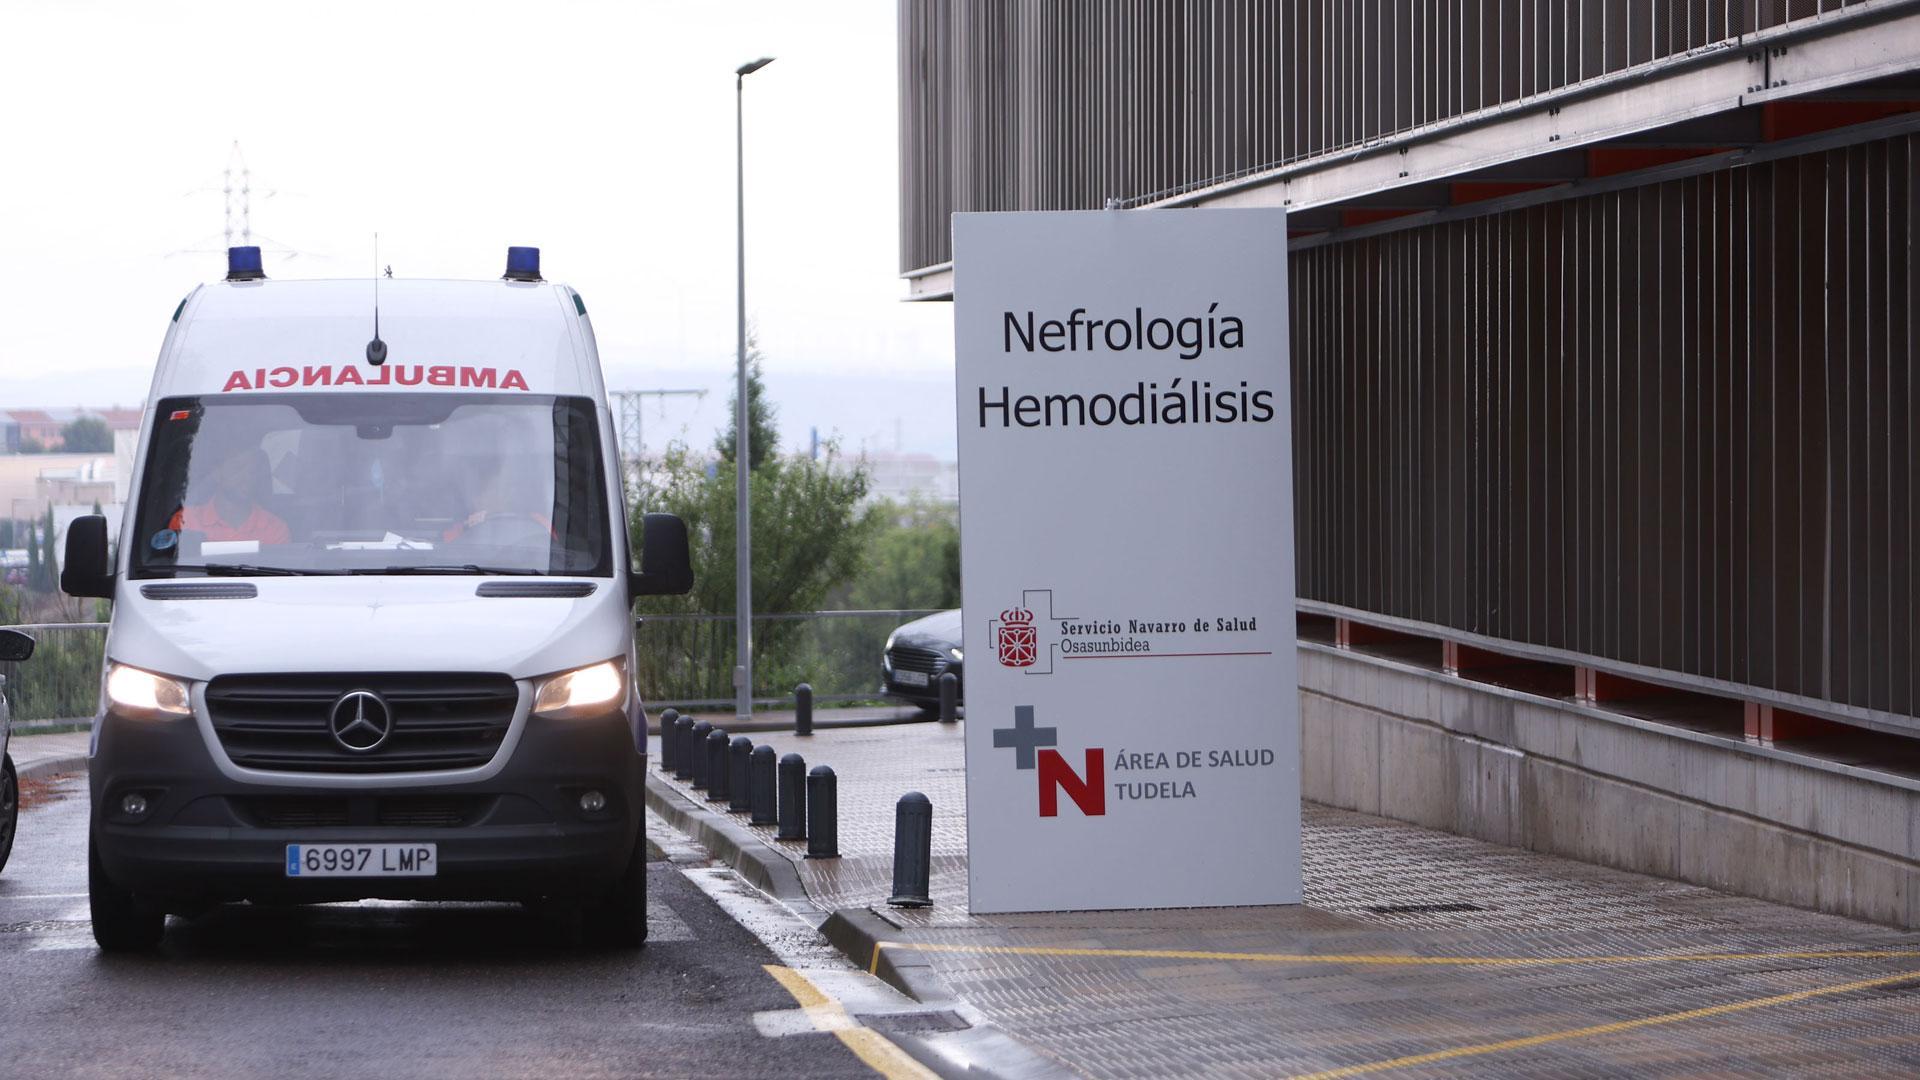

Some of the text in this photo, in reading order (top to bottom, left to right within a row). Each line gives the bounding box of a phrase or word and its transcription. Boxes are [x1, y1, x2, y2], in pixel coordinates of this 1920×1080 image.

[1004, 302, 1244, 360] Nefrología
[978, 378, 1274, 428] Hemodiálisis
[1060, 616, 1257, 636] Servicio Navarro de Salud
[1060, 637, 1151, 654] Osasunbidea
[1114, 748, 1275, 771] ÁREA DE SALUD
[1037, 747, 1106, 817] N
[1114, 781, 1197, 801] TUDELA
[305, 848, 431, 872] 6997 LMP
